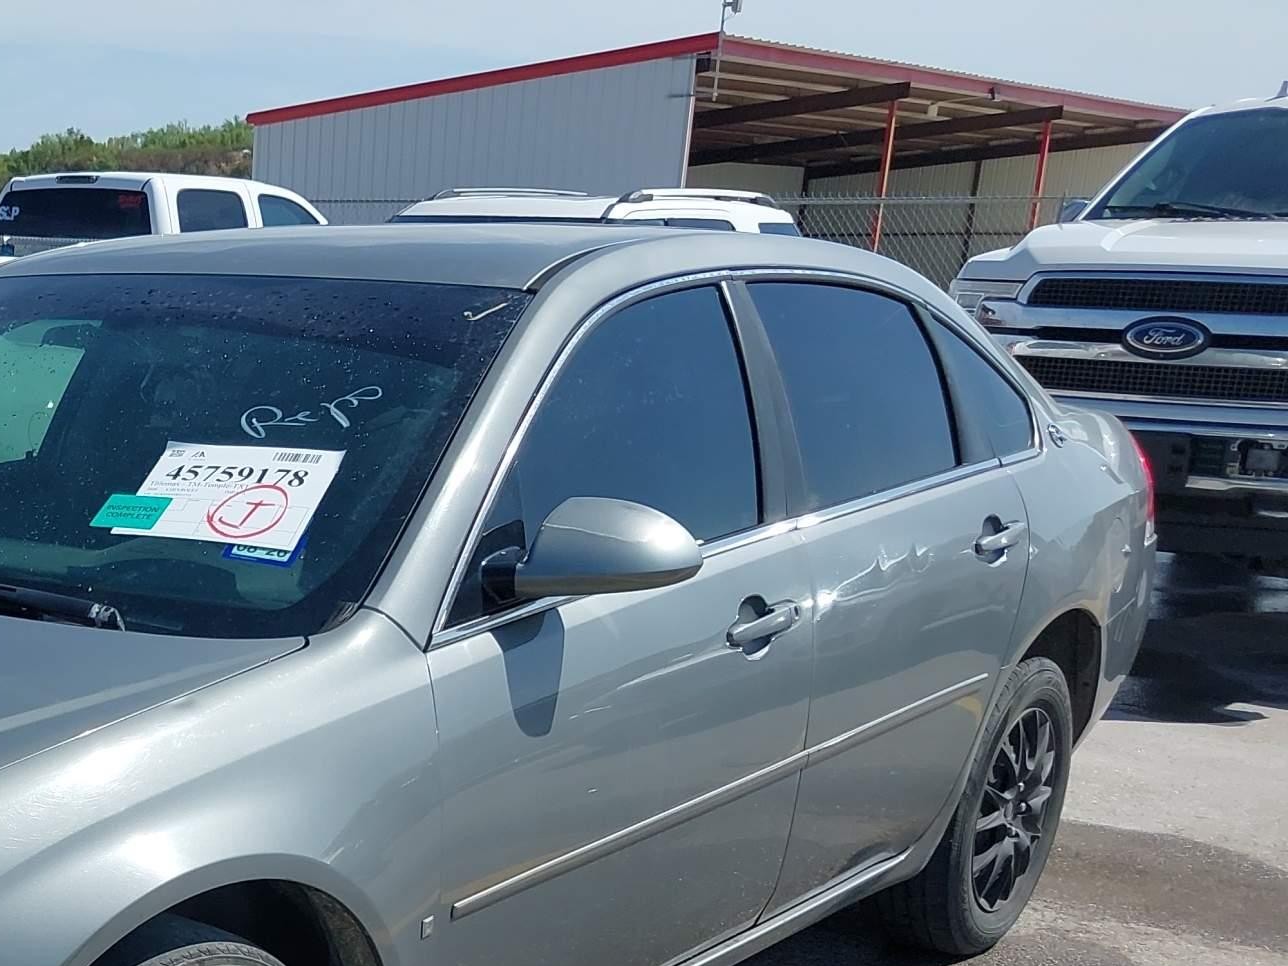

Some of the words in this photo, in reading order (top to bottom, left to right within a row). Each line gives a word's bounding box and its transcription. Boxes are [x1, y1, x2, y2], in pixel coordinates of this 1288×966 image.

[1143, 327, 1186, 345] Ford
[165, 463, 310, 488] 45759178
[105, 504, 160, 513] INSPECTION
[104, 512, 154, 520] COMPLETE
